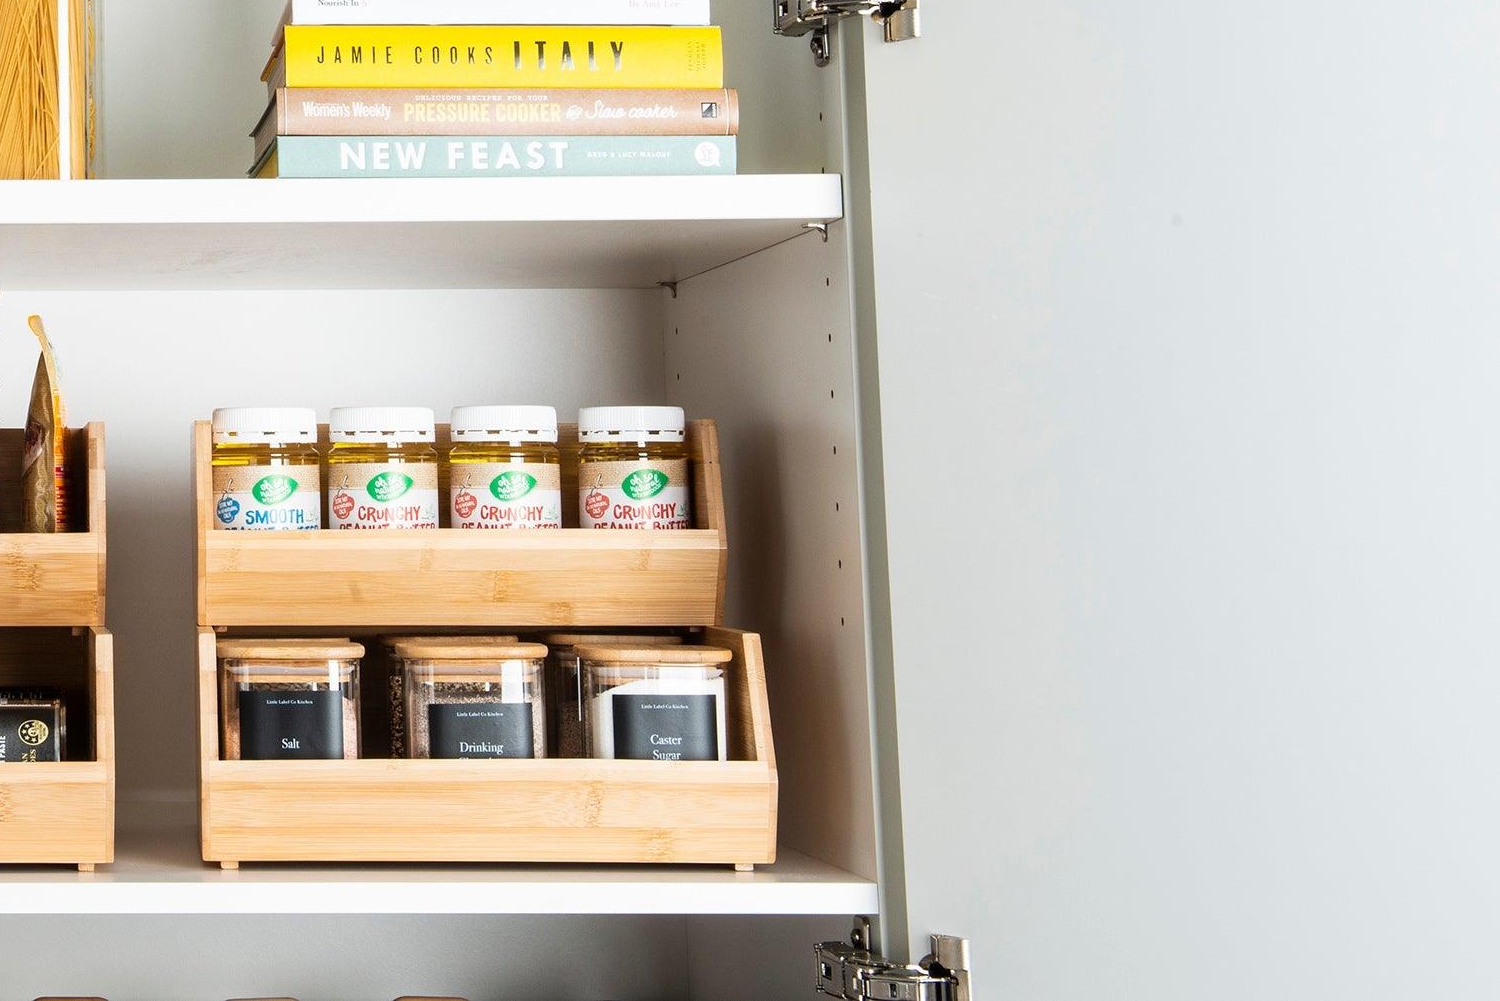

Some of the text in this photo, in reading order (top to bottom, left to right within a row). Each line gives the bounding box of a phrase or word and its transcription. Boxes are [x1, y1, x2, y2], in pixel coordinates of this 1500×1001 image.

[317, 0, 349, 7] Nourish
[350, 0, 359, 7] In
[317, 41, 624, 72] JAMIE COOKS ITALY
[303, 101, 392, 121] Women's Weekly
[404, 103, 491, 123] PRESSURE
[495, 103, 562, 123] COOKER
[340, 141, 569, 170] NEW FEAST
[630, 474, 643, 486] oh
[245, 508, 304, 525] SMOOTH
[281, 738, 300, 749] Salt
[650, 734, 682, 745] Caster
[459, 741, 504, 755] Drinking
[652, 749, 681, 760] Sugar
